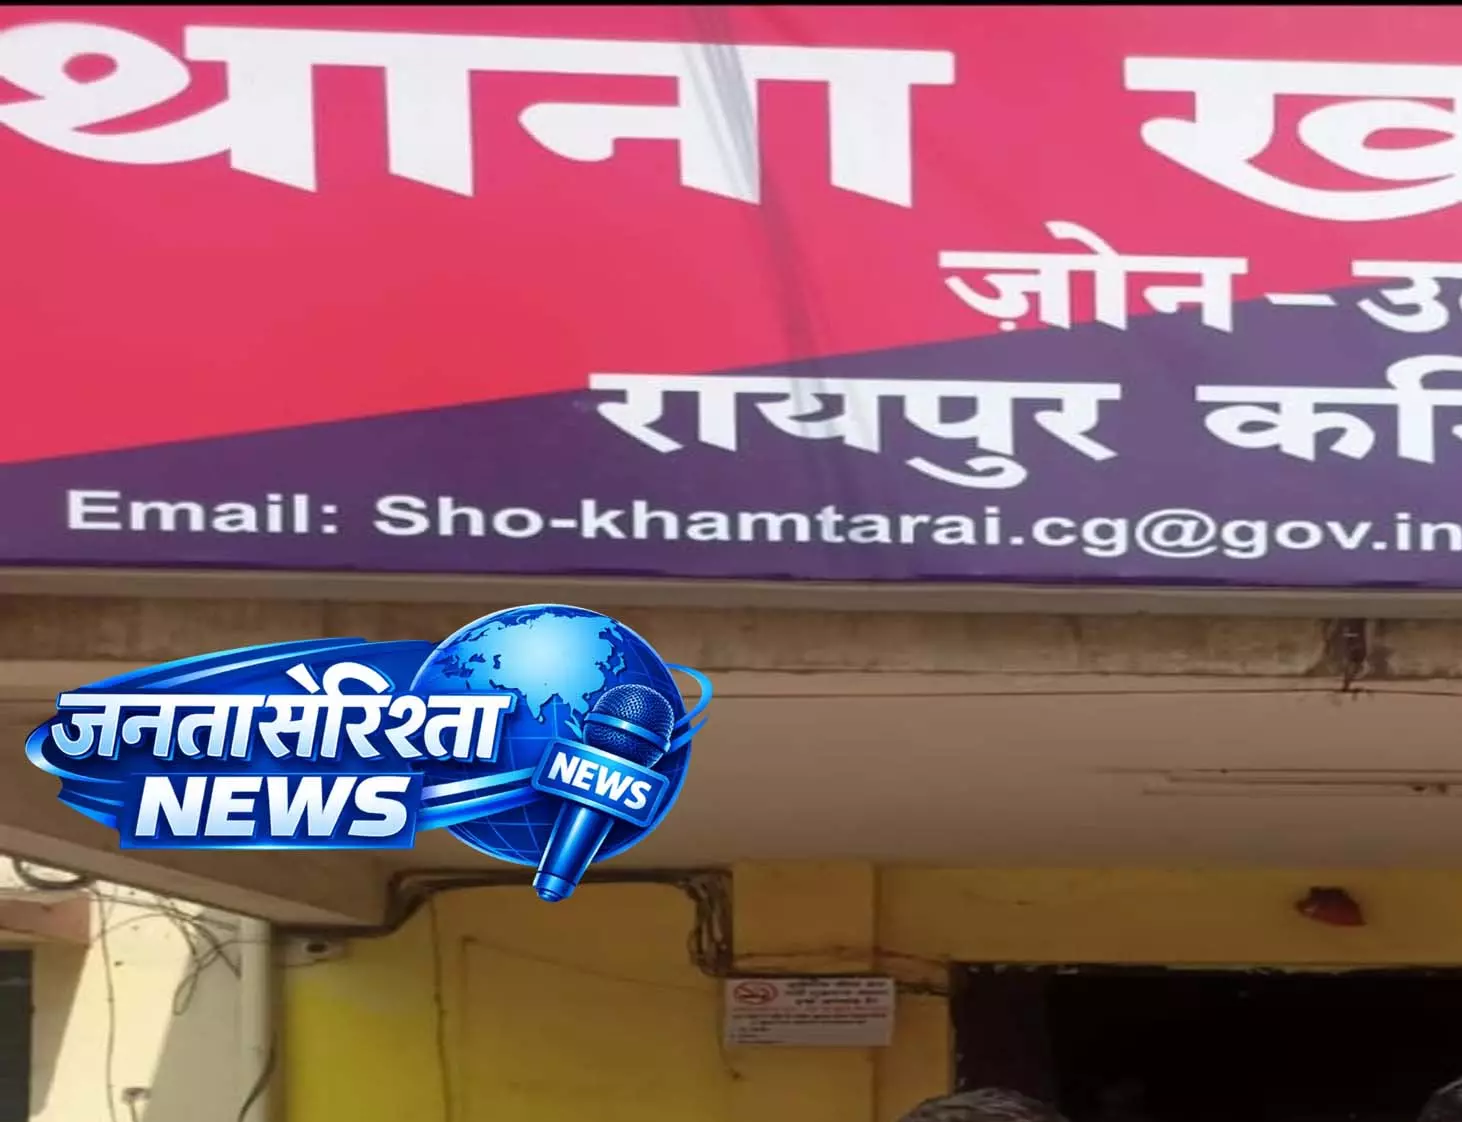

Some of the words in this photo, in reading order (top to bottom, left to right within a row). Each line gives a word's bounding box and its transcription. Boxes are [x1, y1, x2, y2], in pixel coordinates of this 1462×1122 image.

[0, 21, 955, 208] थाना
[588, 373, 1122, 489] रायपुर
[67, 490, 337, 534] Email:
